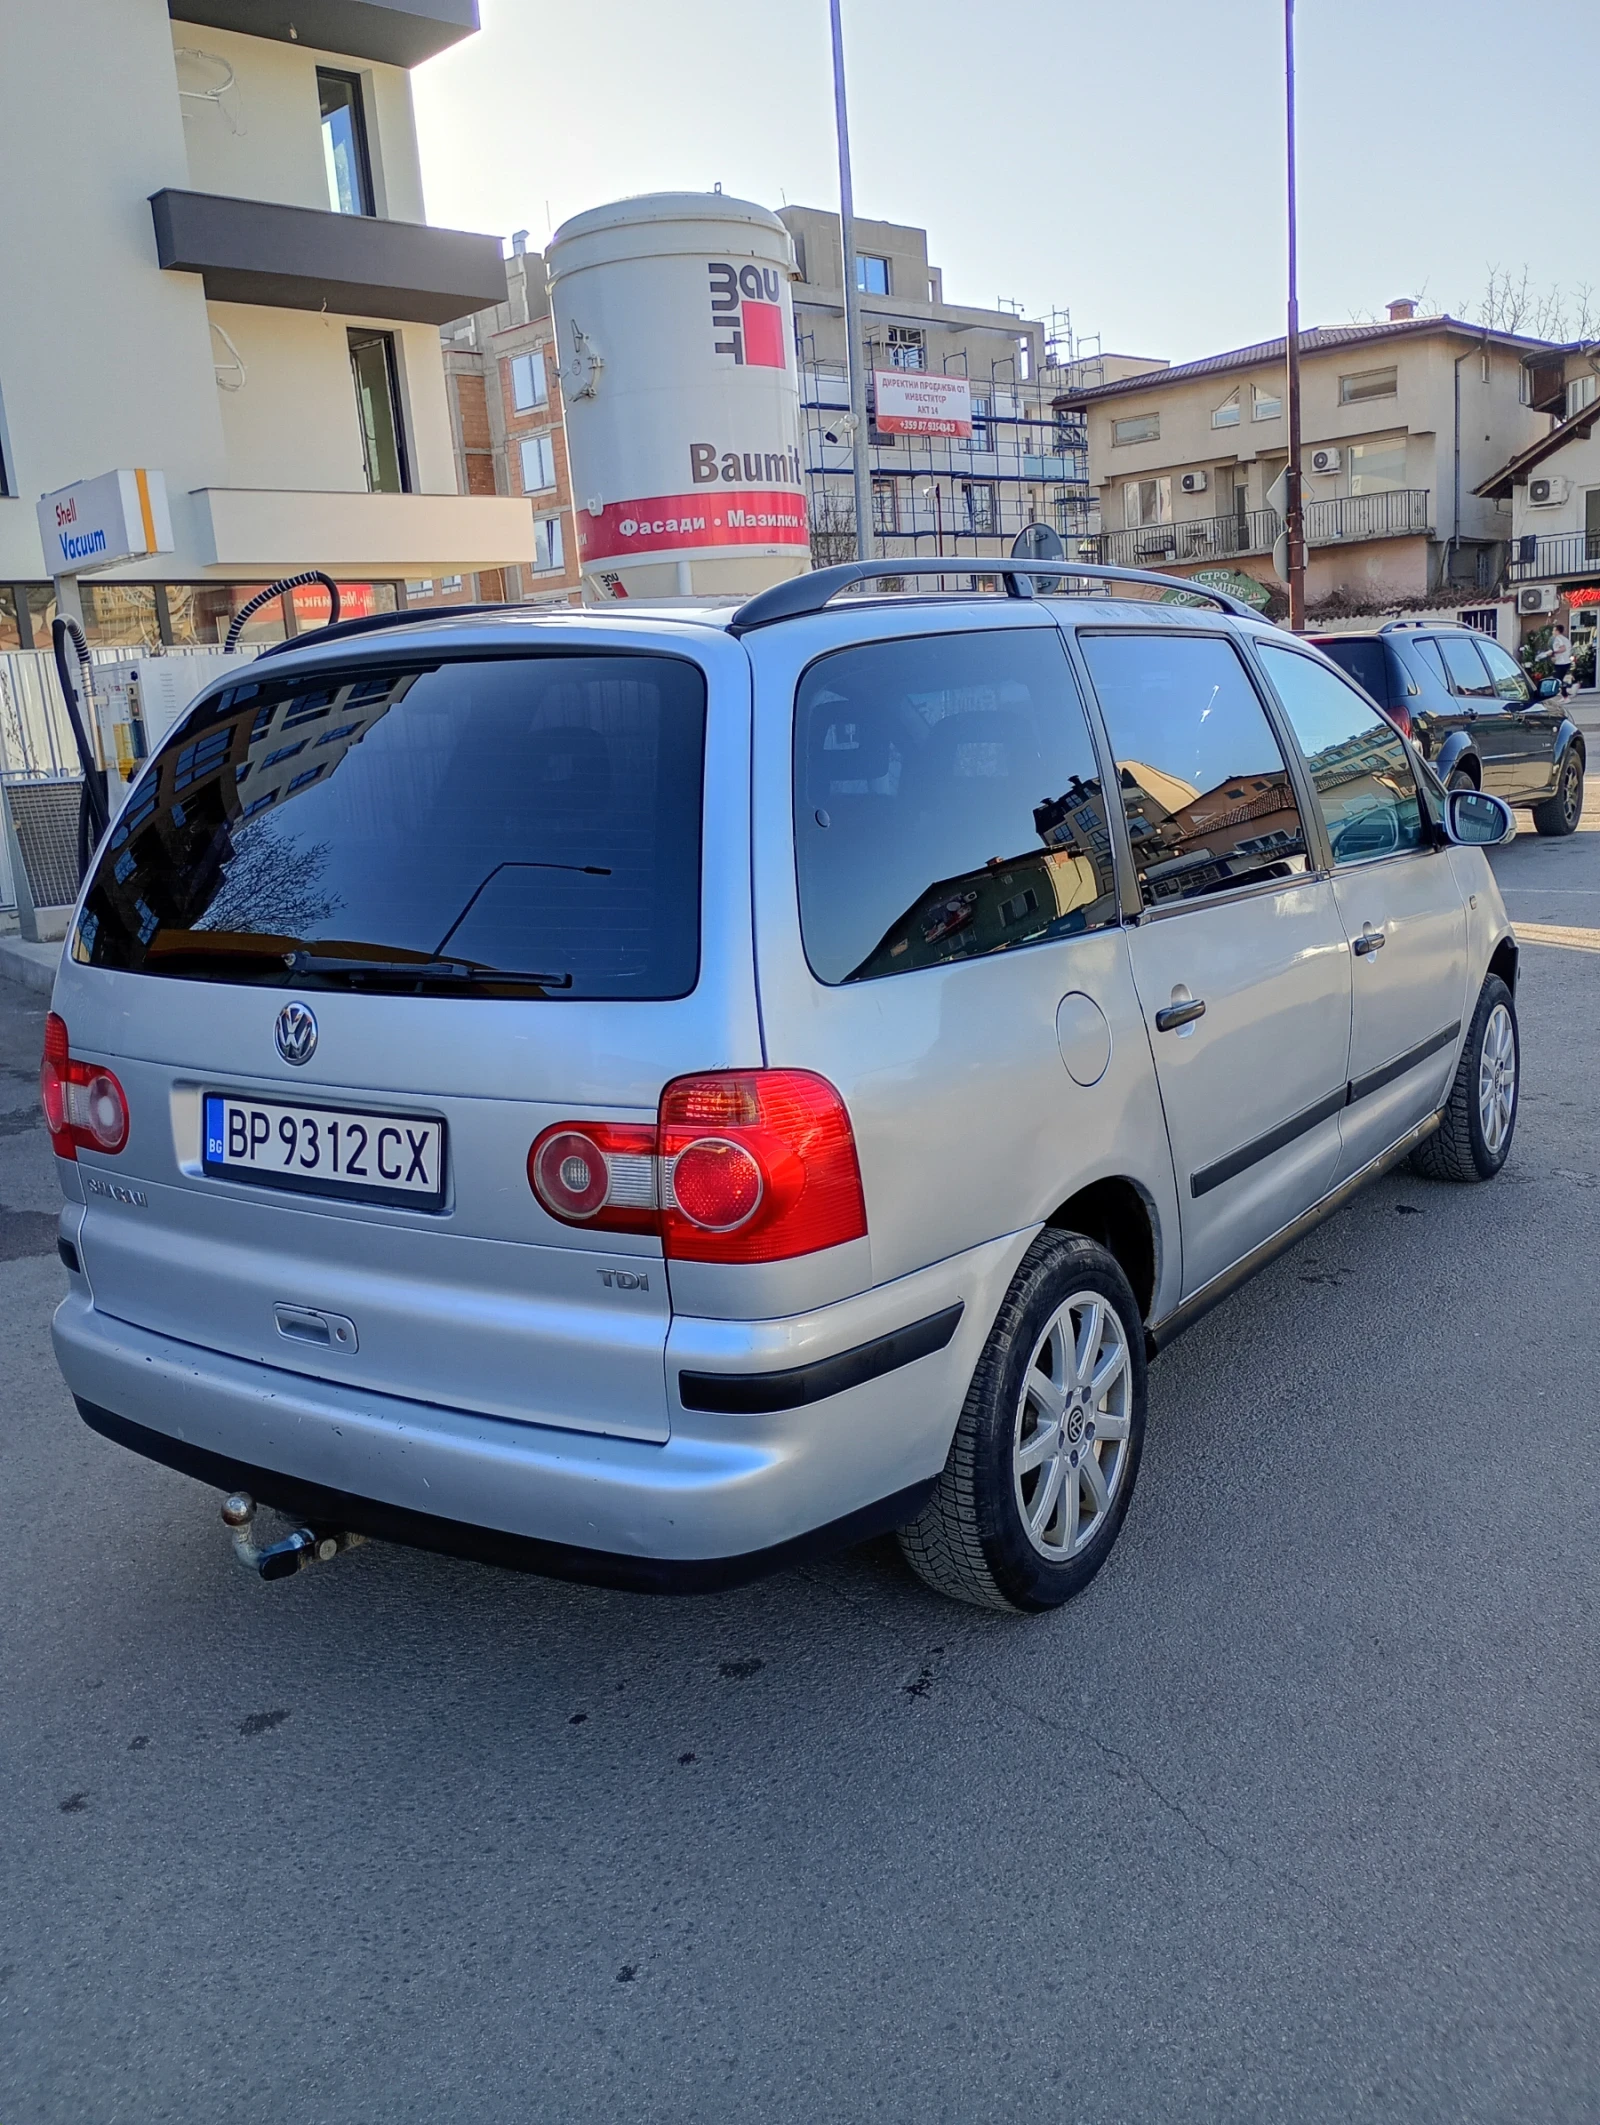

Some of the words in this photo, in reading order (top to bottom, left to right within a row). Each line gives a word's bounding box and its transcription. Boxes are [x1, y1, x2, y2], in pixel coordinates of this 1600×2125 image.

[882, 378, 919, 388] ДИРЕКТНИ
[919, 381, 956, 392] ПРОДАЖБИ
[956, 385, 965, 393] ОТ
[905, 392, 947, 403] ИНВЕСТИТОР
[917, 405, 929, 414] АКТ
[931, 406, 939, 415] 14
[900, 420, 917, 430] +359
[918, 421, 927, 431] 87
[690, 443, 801, 485] Baumit
[55, 497, 77, 527] Shell
[618, 516, 706, 537] Фасади
[727, 510, 798, 528] Мазилки
[59, 529, 106, 561] Vacuum
[209, 1138, 222, 1154] BG
[278, 1115, 368, 1176] 9312
